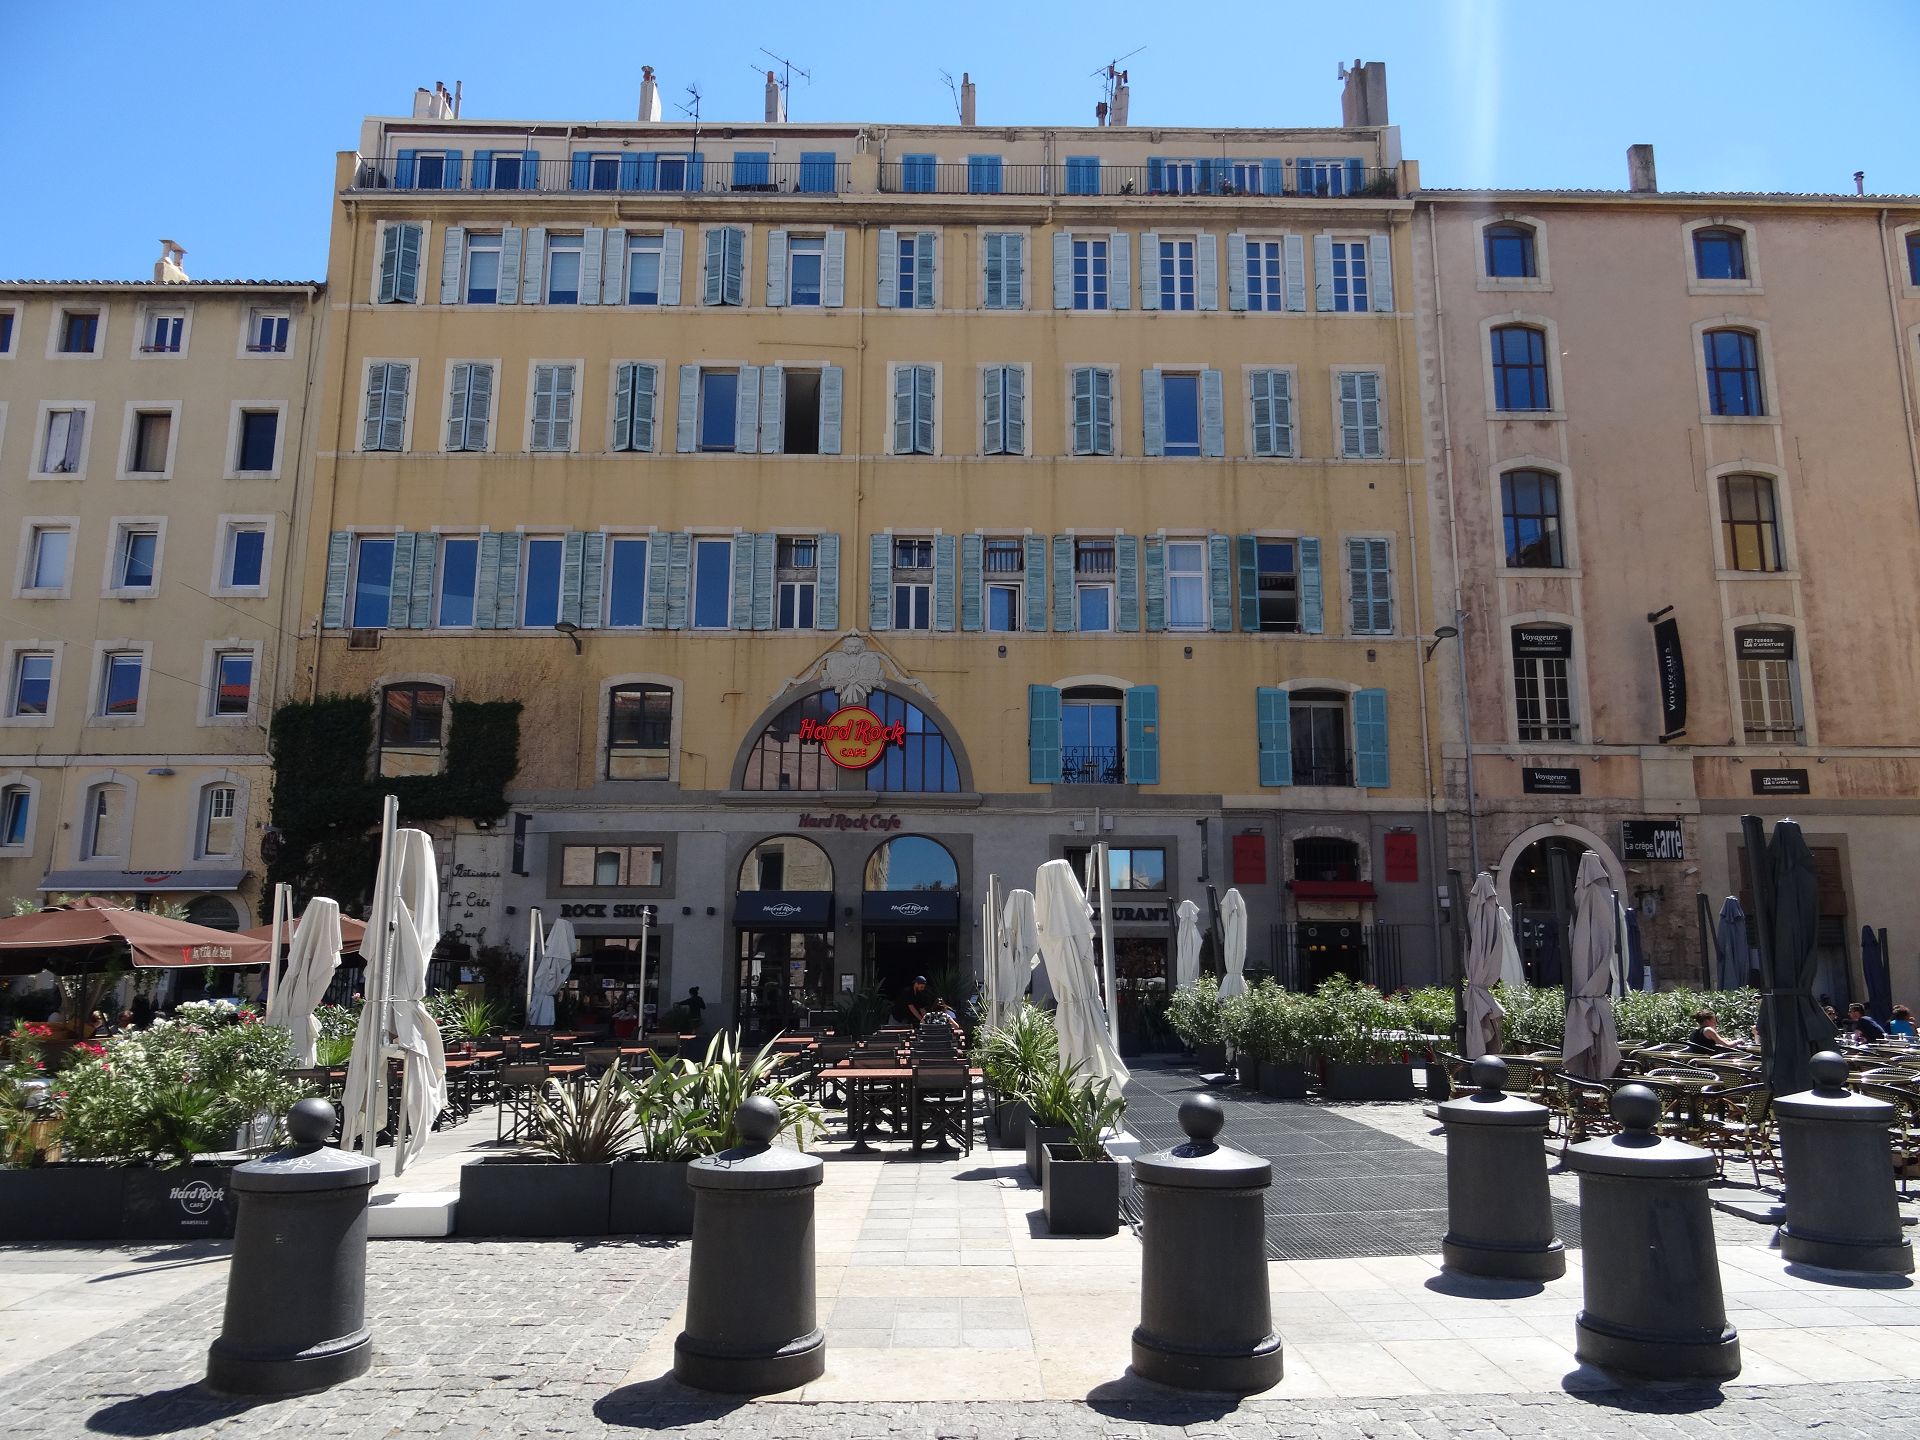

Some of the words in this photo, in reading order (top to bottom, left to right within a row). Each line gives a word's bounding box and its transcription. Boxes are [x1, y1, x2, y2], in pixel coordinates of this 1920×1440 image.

[1521, 632, 1558, 642] Voyageurs
[799, 718, 853, 741] Hard
[854, 719, 905, 746] Rock
[840, 747, 867, 758] CAFE
[1534, 772, 1567, 781] Voyageurs
[798, 813, 834, 828] Hard
[834, 813, 869, 832] Rock
[869, 814, 901, 832] Cafe
[1624, 841, 1634, 850] La
[1653, 821, 1683, 859] carré
[448, 891, 462, 908] La
[560, 904, 607, 918] ROCK
[782, 905, 802, 913] Rock
[910, 904, 929, 912] Rock
[463, 910, 474, 918] de
[169, 1188, 198, 1199] Hard
[198, 1188, 225, 1201] Rock
